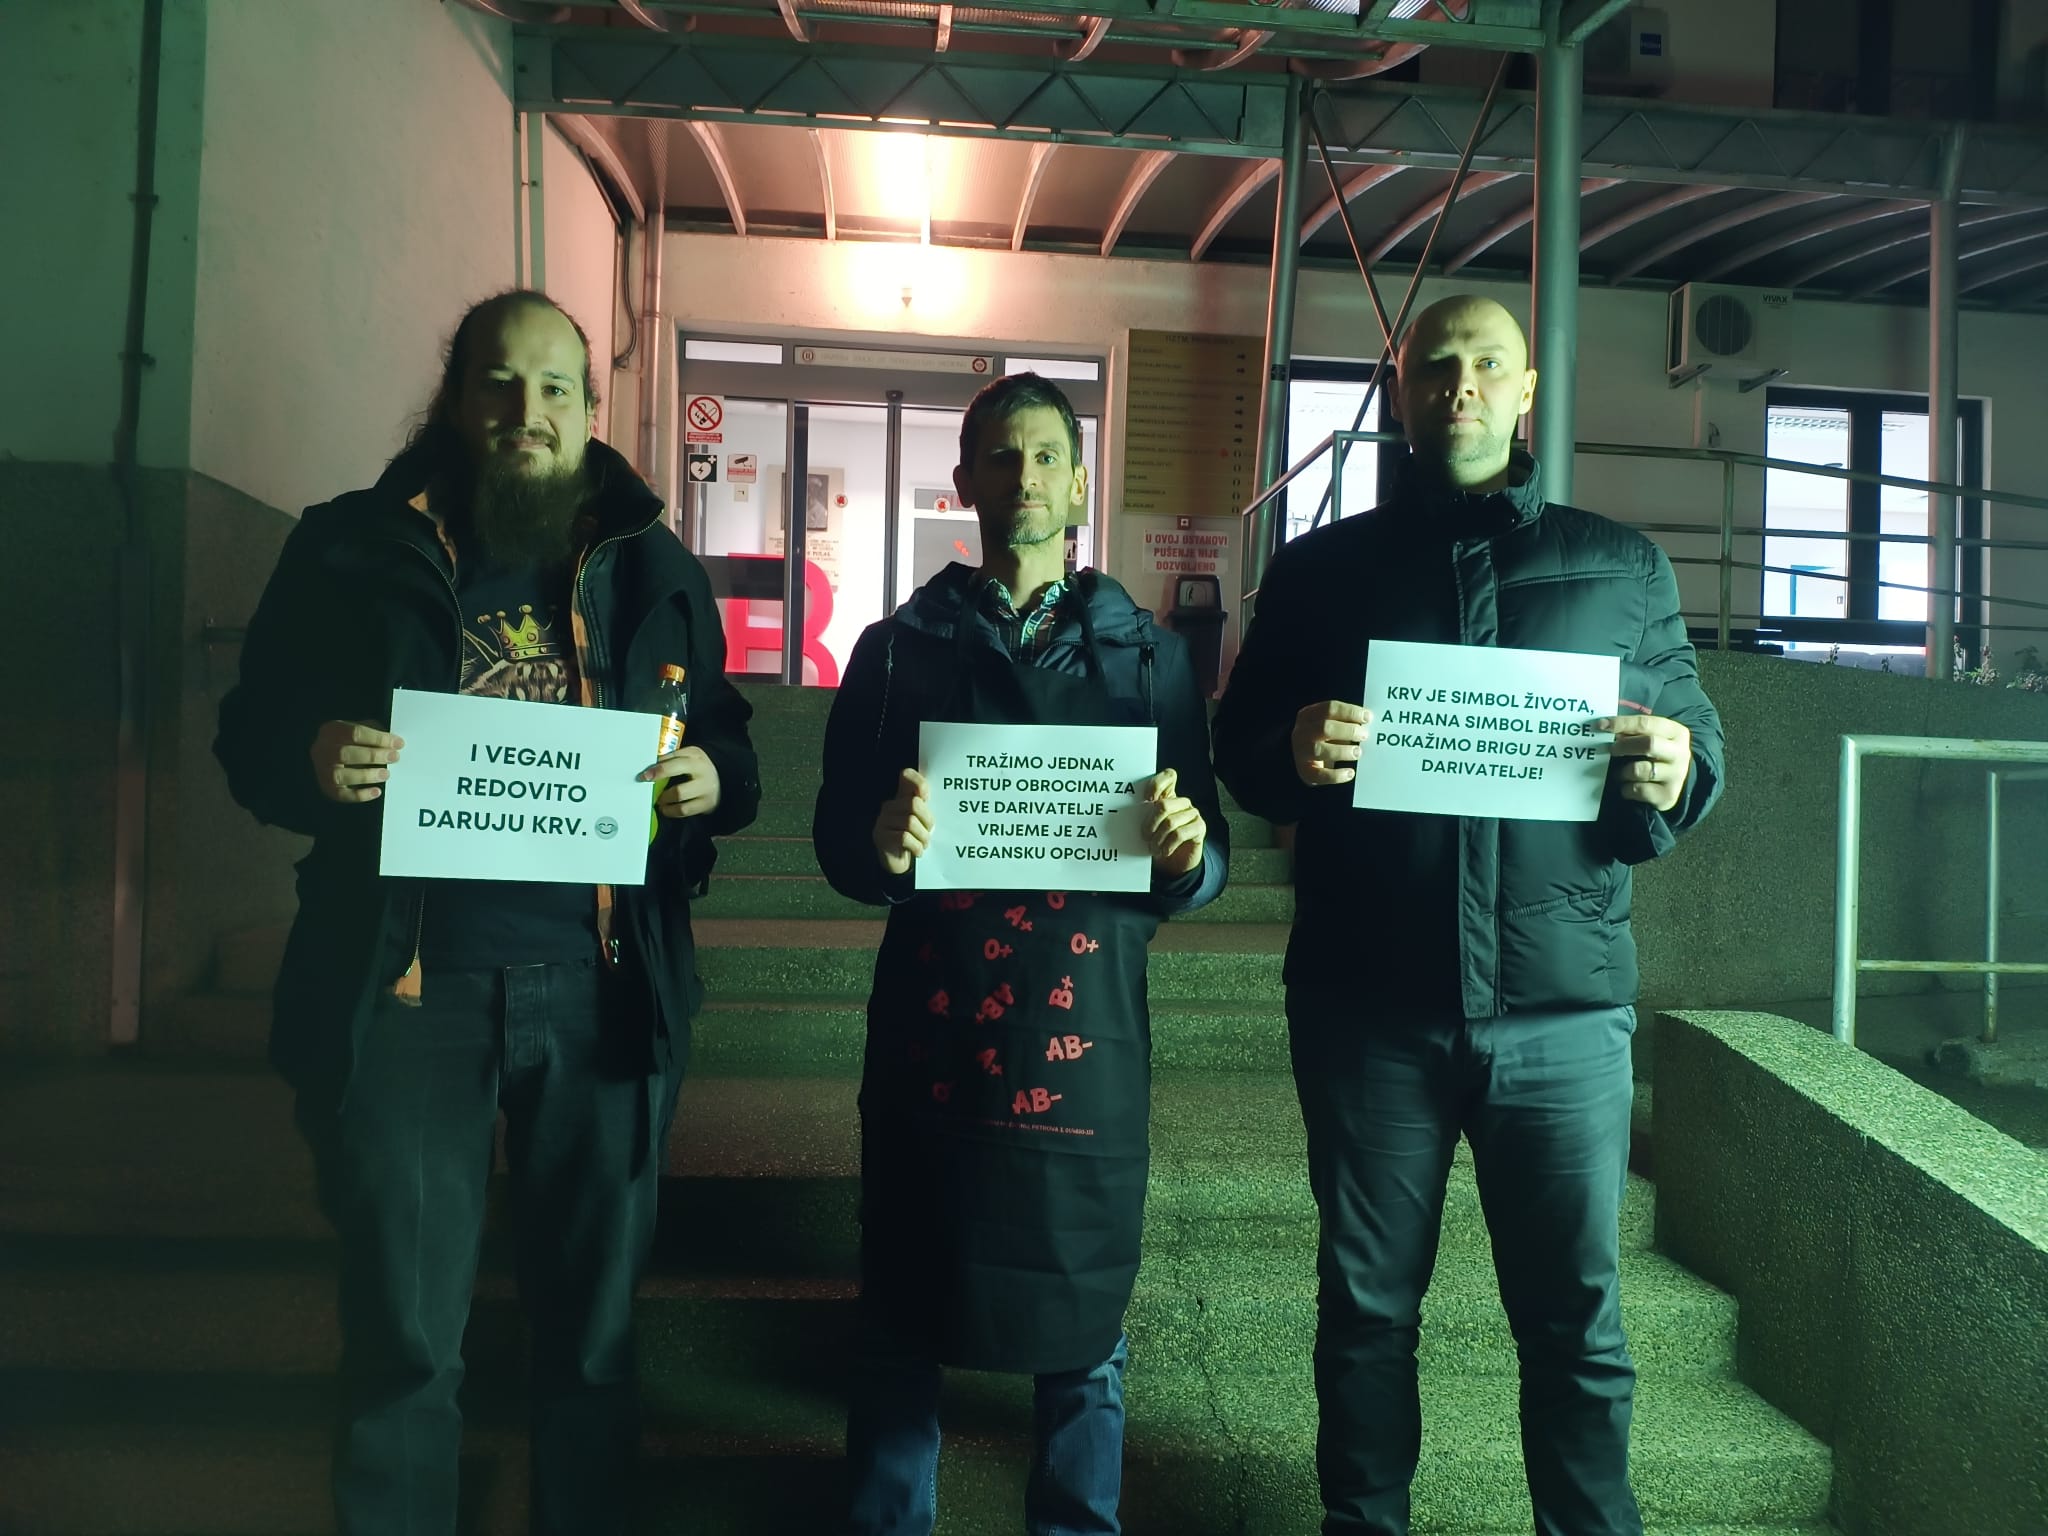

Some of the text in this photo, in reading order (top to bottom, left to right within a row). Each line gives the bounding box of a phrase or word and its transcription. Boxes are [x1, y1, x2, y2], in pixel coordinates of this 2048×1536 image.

[1763, 294, 1787, 303] VIVAX
[1145, 533, 1228, 545] U OVOJ USTANOVI
[1153, 546, 1219, 558] PUŠENJE NIJE
[1156, 560, 1216, 571] DOZVOLJENO
[1387, 686, 1595, 716] KRV JE SIMBOL ŽIVOTA,
[1381, 709, 1595, 738] A HRANA SIMBOL BRIGE.
[470, 743, 581, 770] I VEGANI
[1376, 732, 1596, 761] POKAŽIMO BRIGU ZA SVE
[966, 752, 1115, 771] TRAŽIMO JEDNAK
[1421, 759, 1543, 780] DARIVATELJE!
[456, 776, 588, 803] REDOVITO
[943, 777, 1135, 795] PRISTUP OBROCIMA ZA
[958, 800, 990, 813] SVE
[994, 801, 1104, 816] DARIVATELJE
[418, 808, 588, 837] DARUJU KRV.
[978, 823, 1098, 838] VRIJEME JE ZA
[956, 845, 1118, 862] VEGANSKU OPCIJU!
[1049, 975, 1074, 1010] B+
[1046, 1035, 1093, 1062] AB-
[1012, 1087, 1062, 1115] AB-
